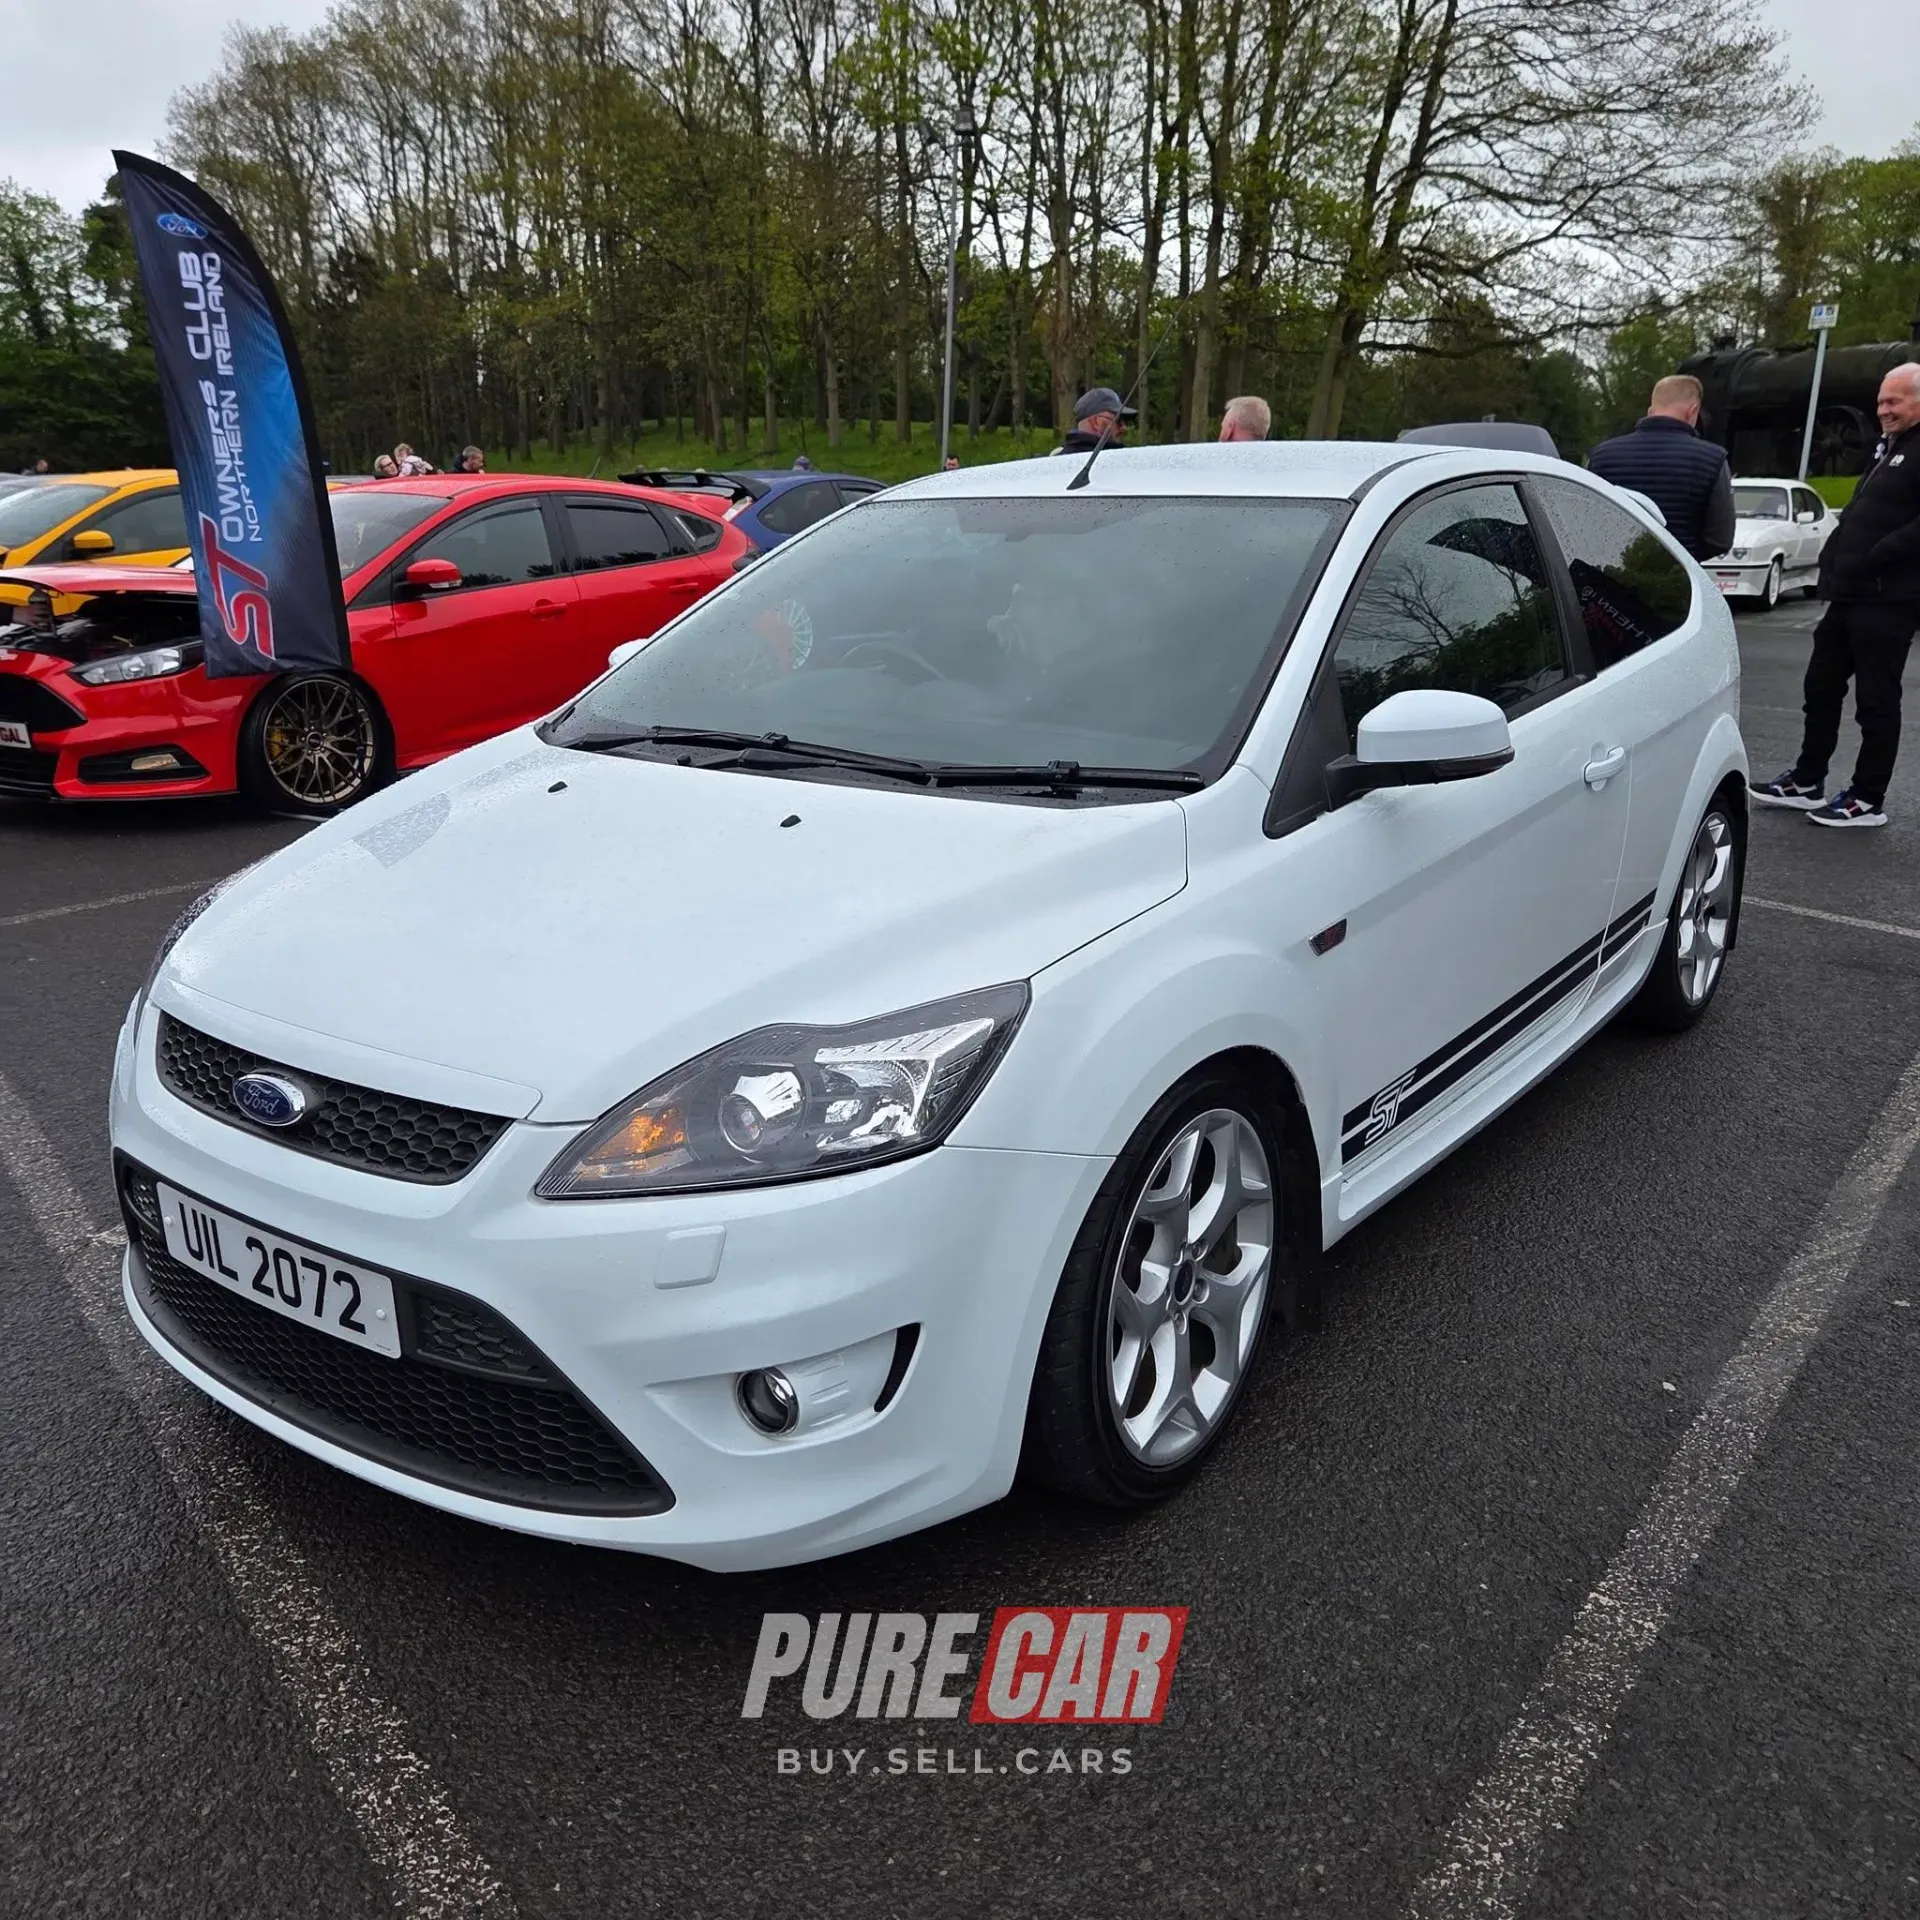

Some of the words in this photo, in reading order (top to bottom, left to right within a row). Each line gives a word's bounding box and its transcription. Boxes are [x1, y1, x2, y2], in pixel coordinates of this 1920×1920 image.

[178, 251, 213, 361] CLUB
[202, 252, 235, 376] IRELAND
[199, 379, 245, 543] OWNERS
[219, 389, 264, 543] NORTHERN
[198, 510, 276, 661] ST
[243, 1083, 280, 1116] Ford
[1364, 1067, 1417, 1147] ST
[178, 1201, 240, 1283] UIL
[245, 1235, 367, 1335] 2072
